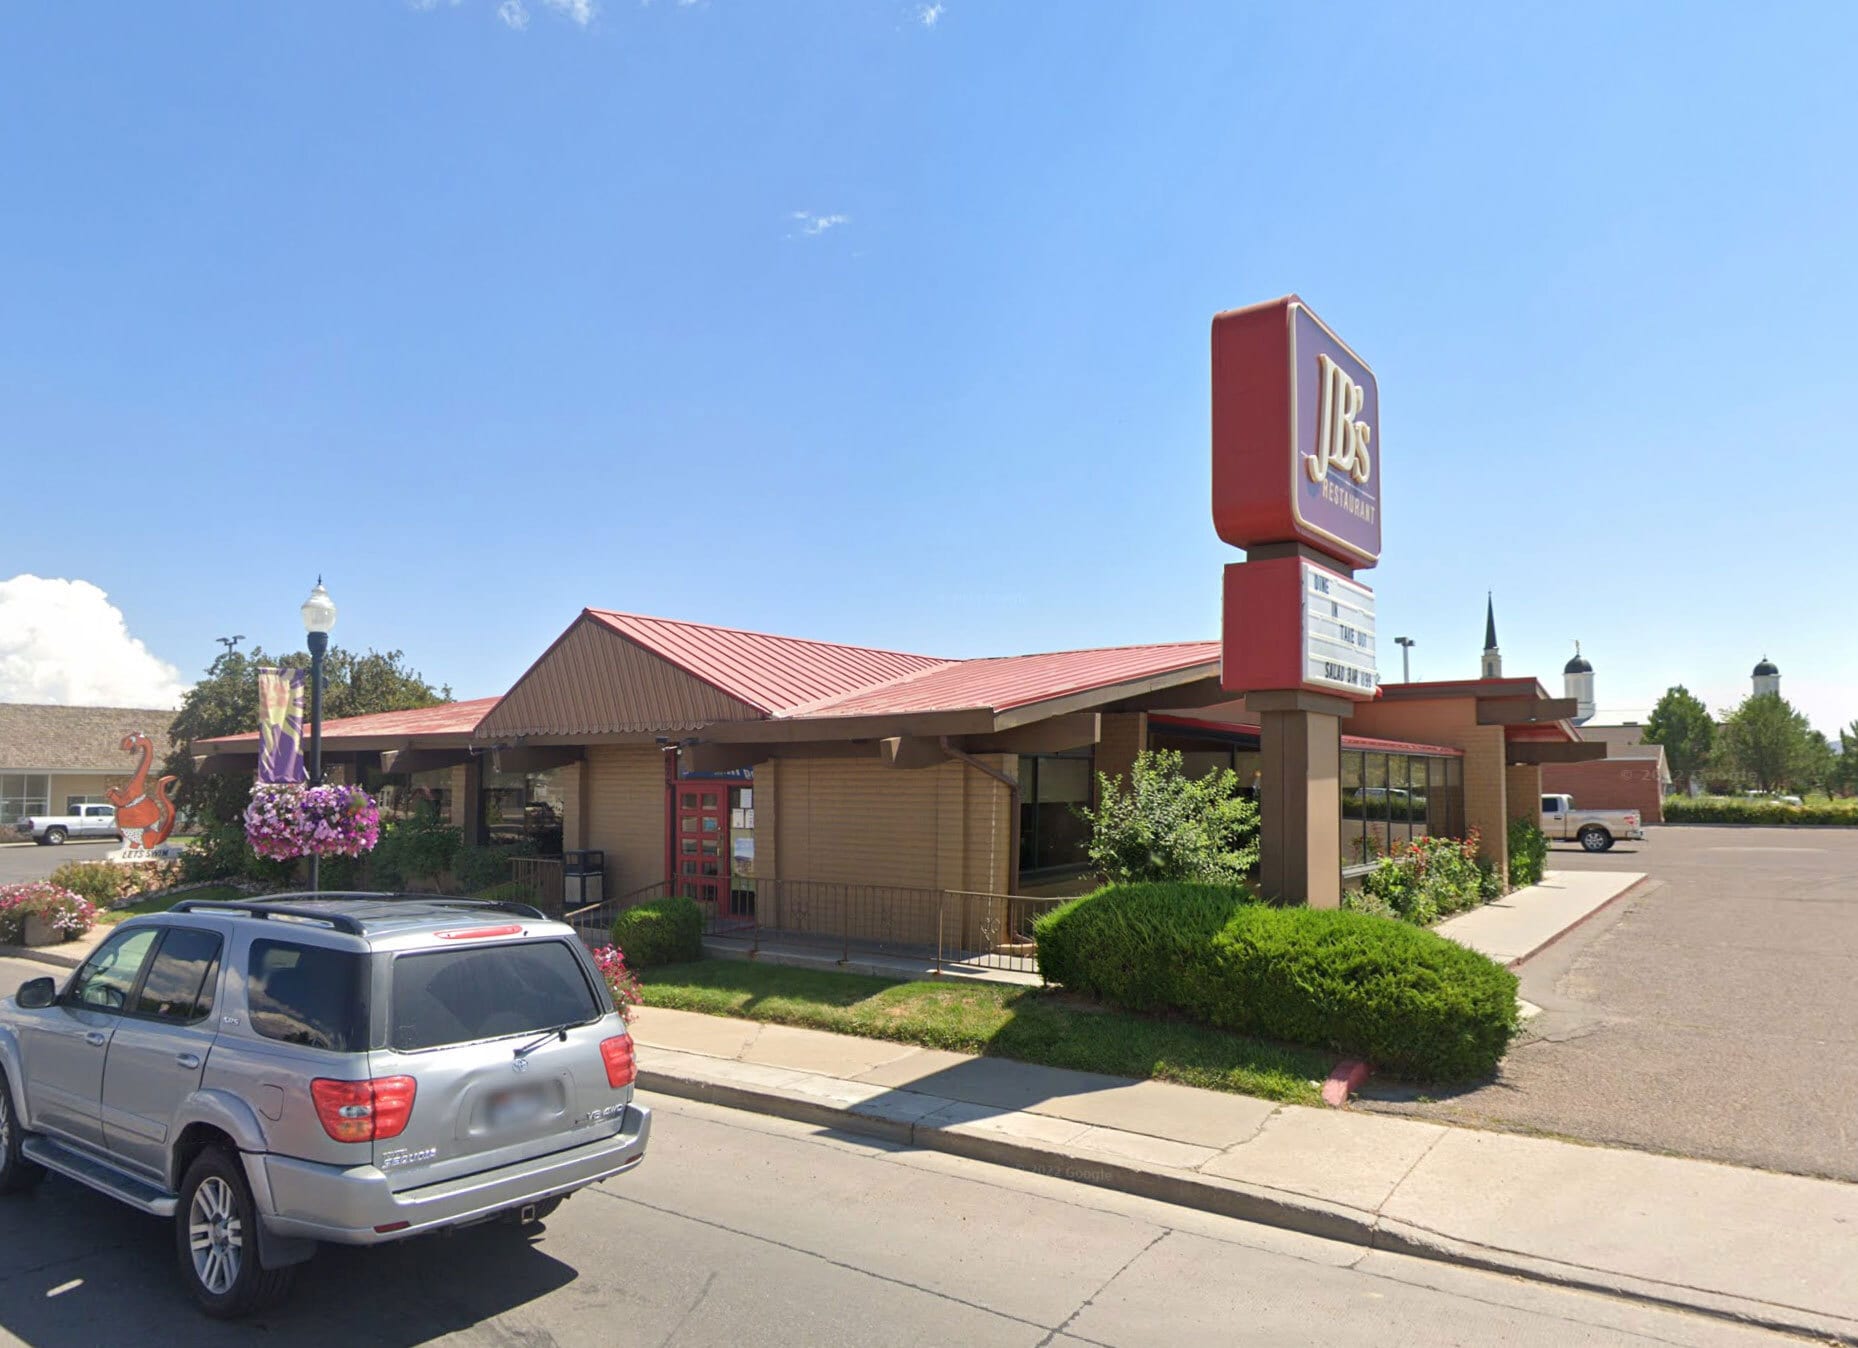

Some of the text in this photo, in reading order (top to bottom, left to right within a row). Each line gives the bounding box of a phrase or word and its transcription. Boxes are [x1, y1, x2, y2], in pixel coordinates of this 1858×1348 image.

[1308, 353, 1371, 485] JB's
[1321, 478, 1376, 526] RESTAURANT
[1313, 574, 1330, 595] DINE
[1340, 624, 1368, 648] TAKE OUT
[1324, 661, 1345, 682] SALAD
[1347, 667, 1358, 685] BAR
